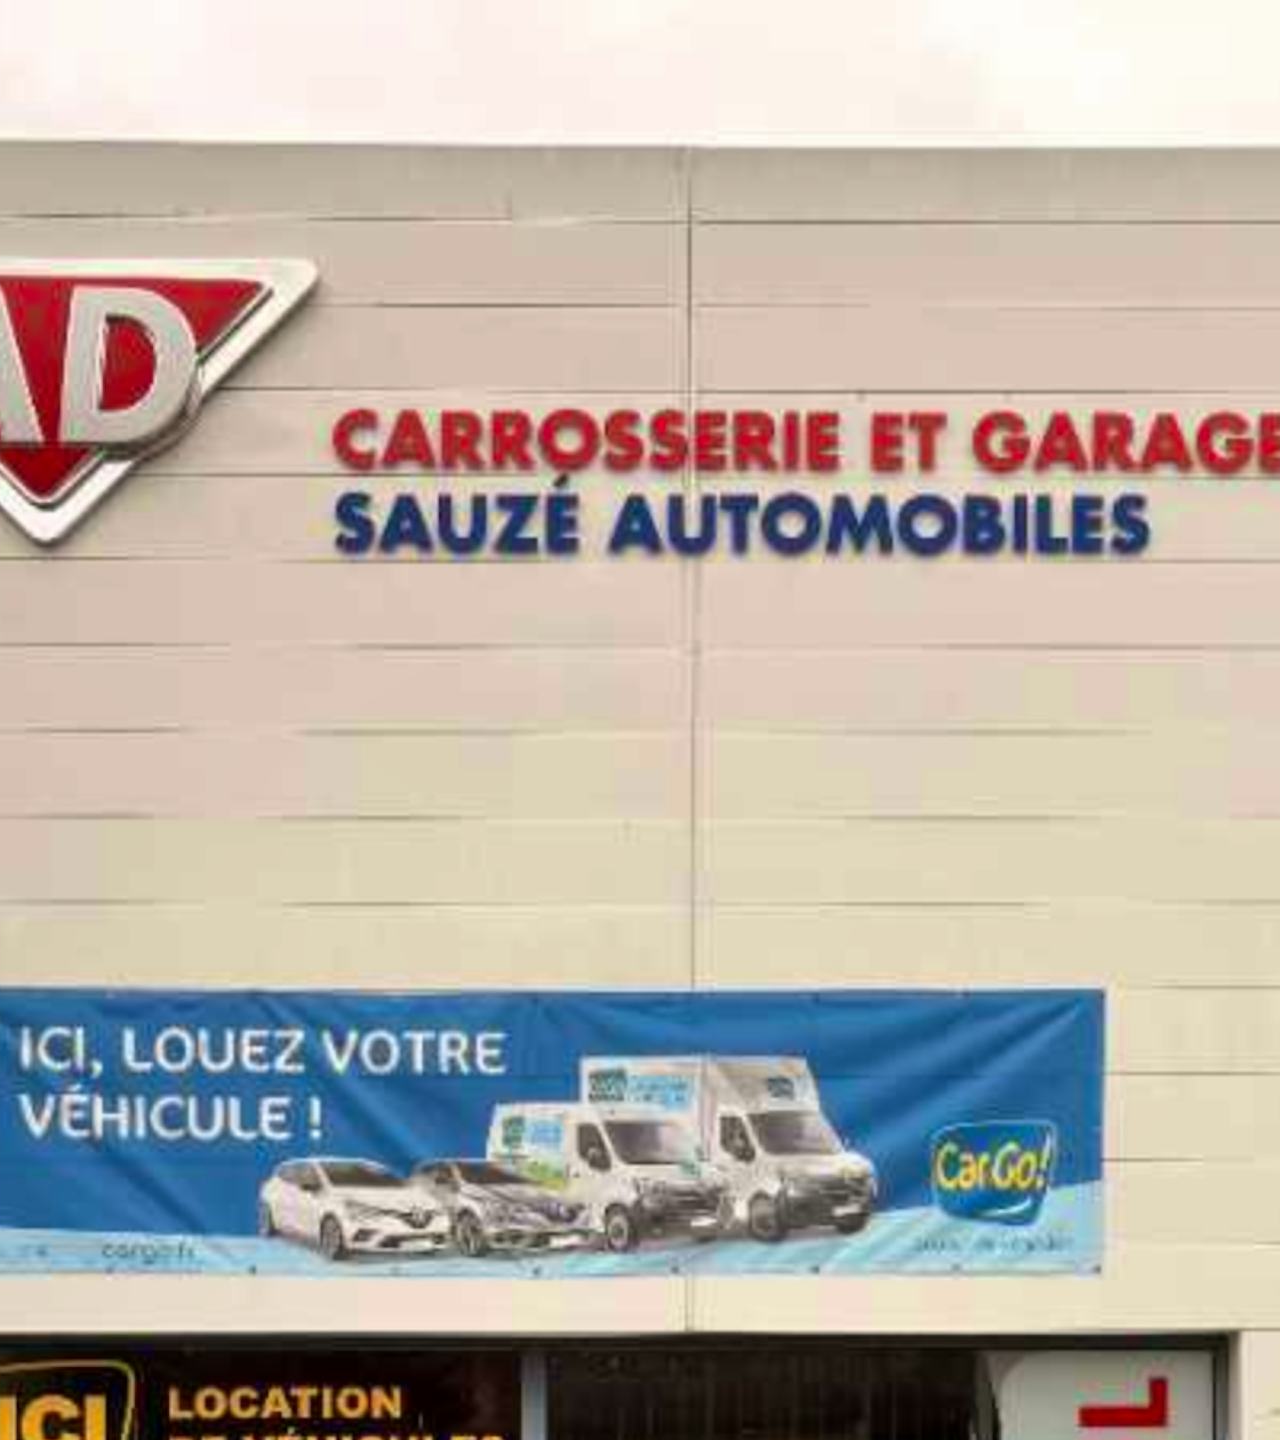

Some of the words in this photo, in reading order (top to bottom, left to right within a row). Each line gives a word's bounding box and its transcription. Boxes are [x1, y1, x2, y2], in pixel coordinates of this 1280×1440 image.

[332, 408, 841, 473] CARROSSERIE
[869, 411, 947, 473] ET
[335, 474, 580, 557] SAUZÉ
[608, 493, 1151, 557] AUTOMOBILES
[21, 1027, 103, 1078] ICI,
[123, 1028, 306, 1074] LOUEZ
[324, 1031, 508, 1075] VOTRE
[17, 1083, 292, 1141] VÉHICULE
[168, 1385, 403, 1420] LOCATION
